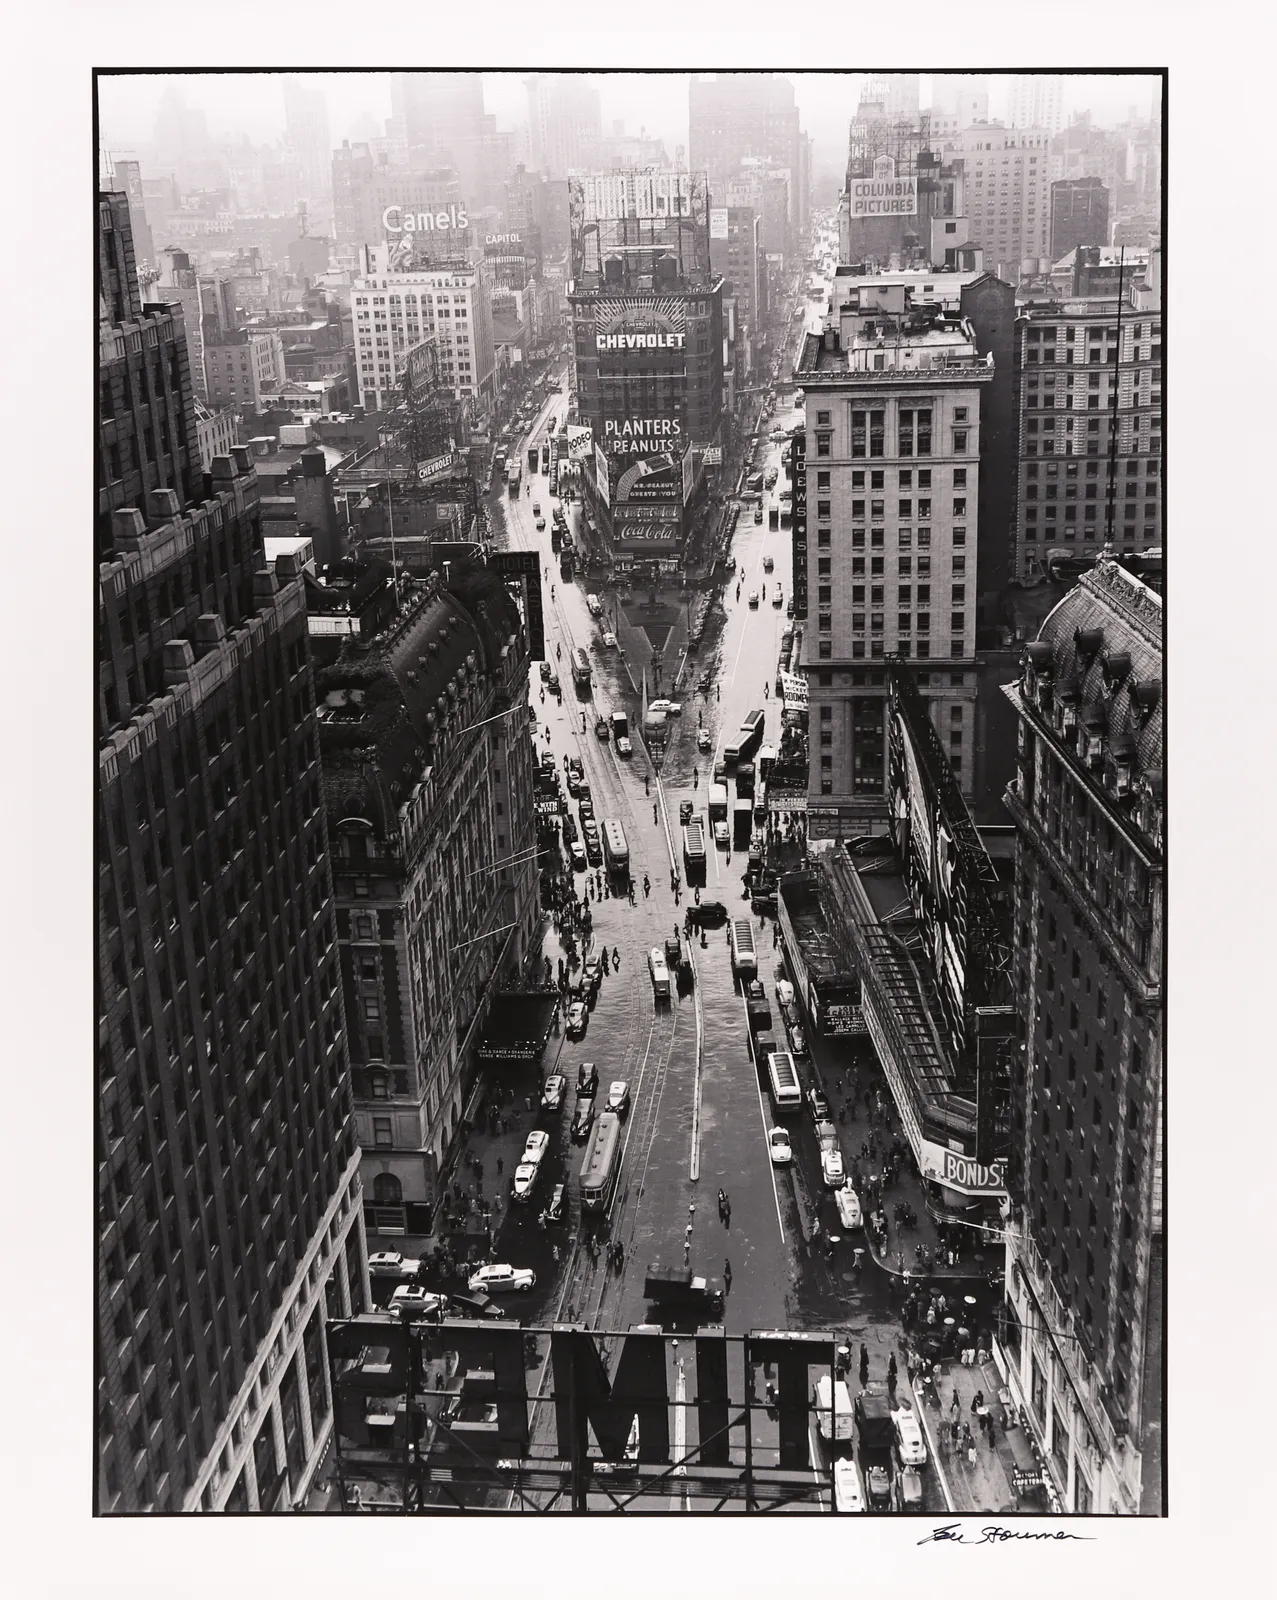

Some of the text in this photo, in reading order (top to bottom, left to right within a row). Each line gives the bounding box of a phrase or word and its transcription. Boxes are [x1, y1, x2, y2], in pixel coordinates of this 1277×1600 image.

[855, 182, 915, 197] COLUMBIA
[855, 199, 913, 213] PICTURES
[382, 204, 469, 233] Camels
[485, 233, 522, 245] CAPITOL
[596, 333, 686, 349] CHEVROLET
[605, 419, 681, 436] PLANTERS
[568, 431, 592, 451] RODEO
[613, 439, 674, 453] PEANUTS
[418, 454, 453, 479] CHEVROLET
[497, 557, 538, 570] HOTEL
[797, 541, 808, 610] STATE
[947, 1155, 1001, 1187] BONDS
